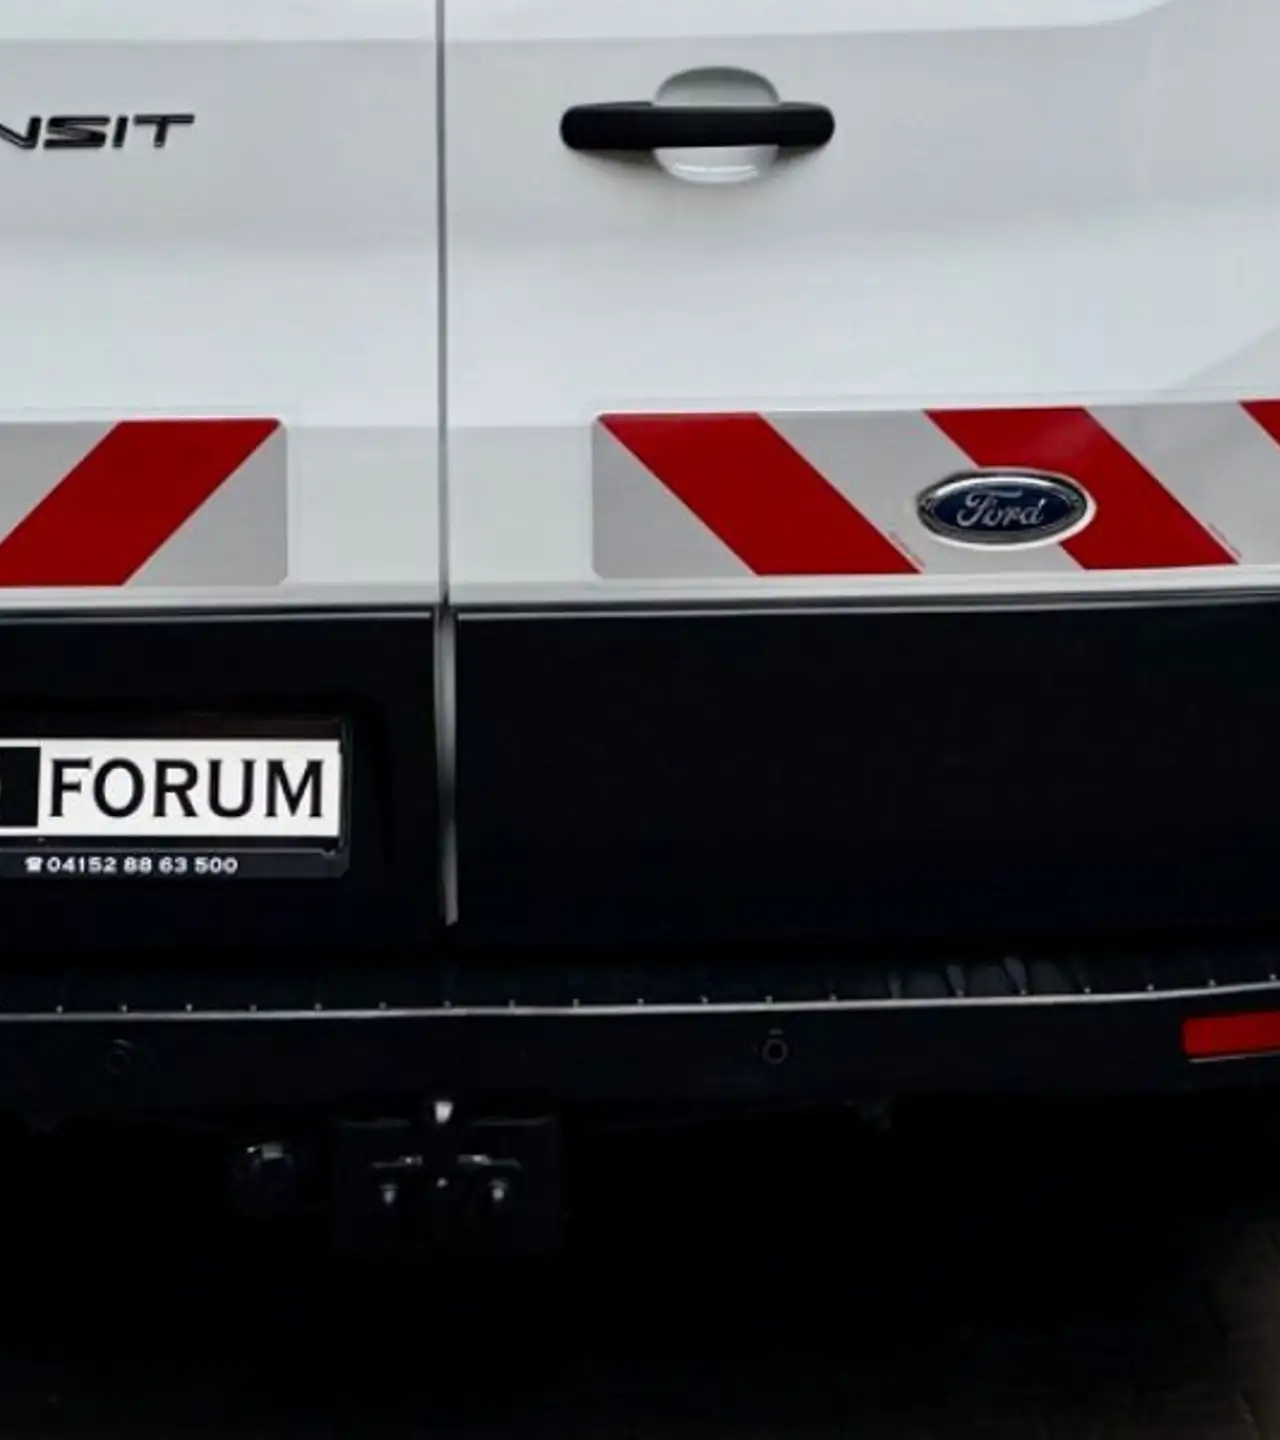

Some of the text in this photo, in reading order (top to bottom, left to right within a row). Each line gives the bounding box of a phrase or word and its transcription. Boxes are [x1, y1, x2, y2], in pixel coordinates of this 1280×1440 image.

[956, 488, 1046, 528] Ford
[49, 758, 324, 819] FORUM
[47, 856, 116, 874] 04152
[123, 856, 153, 874] 88
[158, 856, 188, 874] 63
[194, 856, 239, 874] 500
